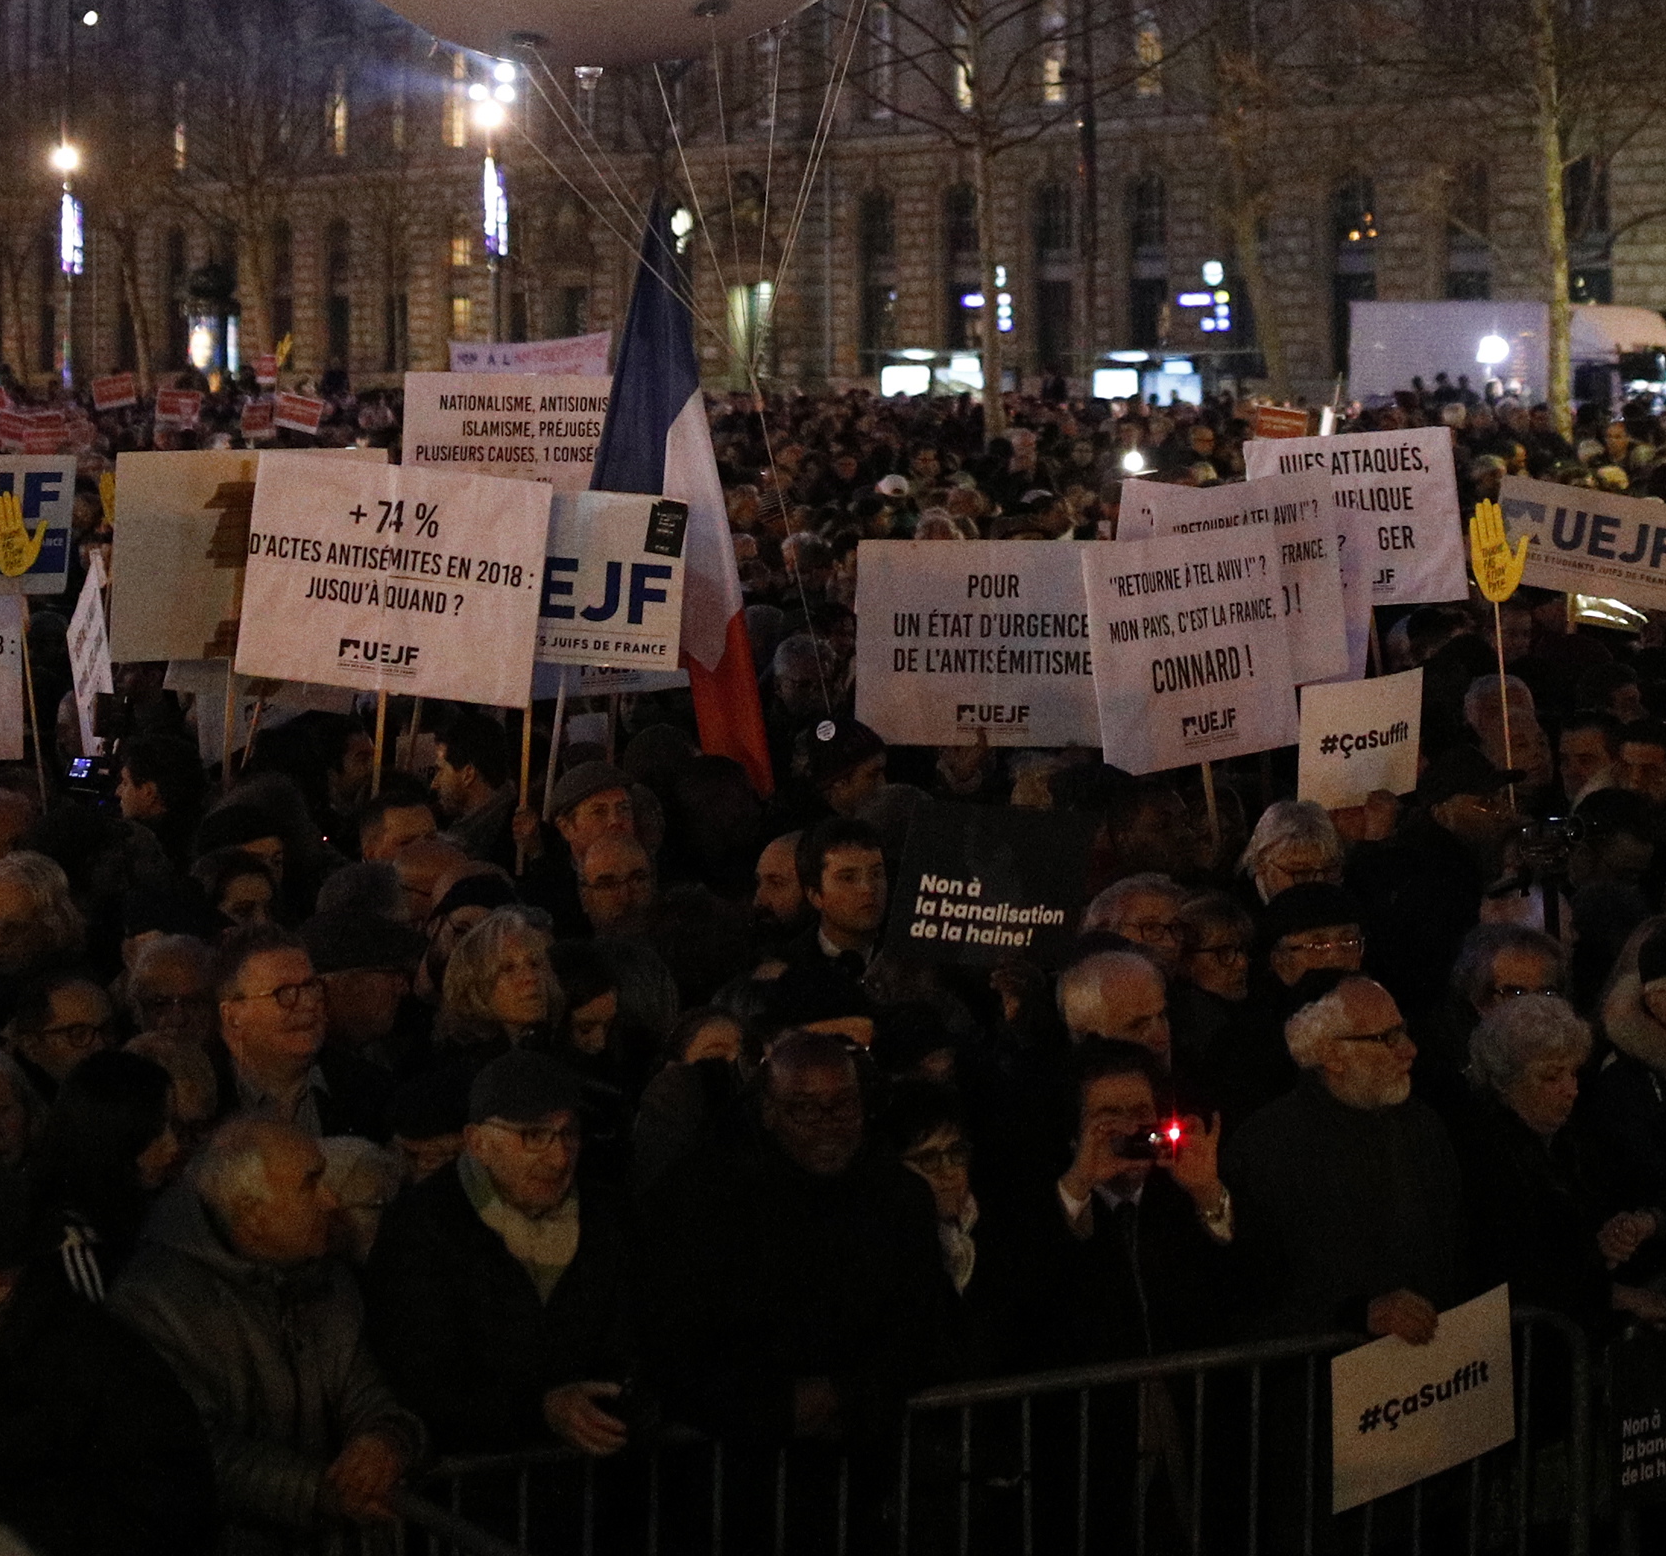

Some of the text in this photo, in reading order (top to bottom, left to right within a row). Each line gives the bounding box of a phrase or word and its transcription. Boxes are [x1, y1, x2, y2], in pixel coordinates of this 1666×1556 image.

[439, 394, 536, 414] NATIONALISME,
[462, 417, 601, 439] ISLAMISME, PRÉJUGÉS
[416, 443, 484, 462] PLUSIEURS
[488, 445, 538, 464] CAUSES,
[544, 447, 550, 462] 1
[1332, 442, 1429, 475] ATTAQUÉS,
[349, 500, 438, 538] + 74 %
[1274, 503, 1297, 525] AVIV
[1311, 498, 1318, 518] ?
[1378, 525, 1415, 551] GER
[249, 533, 321, 562] D'ACTES
[326, 543, 440, 575] ANTISÉMITES
[447, 557, 471, 580] EN
[476, 561, 522, 587] 2018
[1192, 561, 1215, 586] TEL
[1216, 557, 1242, 582] AVIV
[1259, 555, 1267, 576] ?
[539, 556, 673, 625] EJF
[967, 574, 1020, 599] POUR
[1373, 569, 1395, 584] JF
[305, 576, 464, 616] JUSQU'À QUAND ?
[894, 609, 1090, 639] UN ÉTAT D'URGENCE
[1109, 619, 1140, 644] MON
[1142, 614, 1175, 639] PAYS,
[1178, 607, 1208, 634] C'EST
[1211, 604, 1227, 627] LA
[363, 641, 420, 666] UEJF
[551, 637, 589, 650] JUIFS
[593, 640, 610, 652] DE
[614, 641, 667, 657] FRANCE
[893, 645, 1093, 676] DE L'ANTISÉMITISME
[1152, 644, 1254, 694] CONNARD !
[978, 704, 1030, 725] UEJF
[1198, 707, 1237, 735] UEJF
[1320, 720, 1409, 759] #ÇaSuffit
[919, 873, 982, 898] Non à
[914, 894, 1066, 926] la banalisation
[909, 918, 1034, 947] de la haine!
[1359, 1360, 1489, 1433] #ÇaSuffit
[1623, 1417, 1649, 1438] Non
[1622, 1443, 1634, 1462] la
[1622, 1466, 1639, 1486] de
[1640, 1462, 1655, 1482] la
